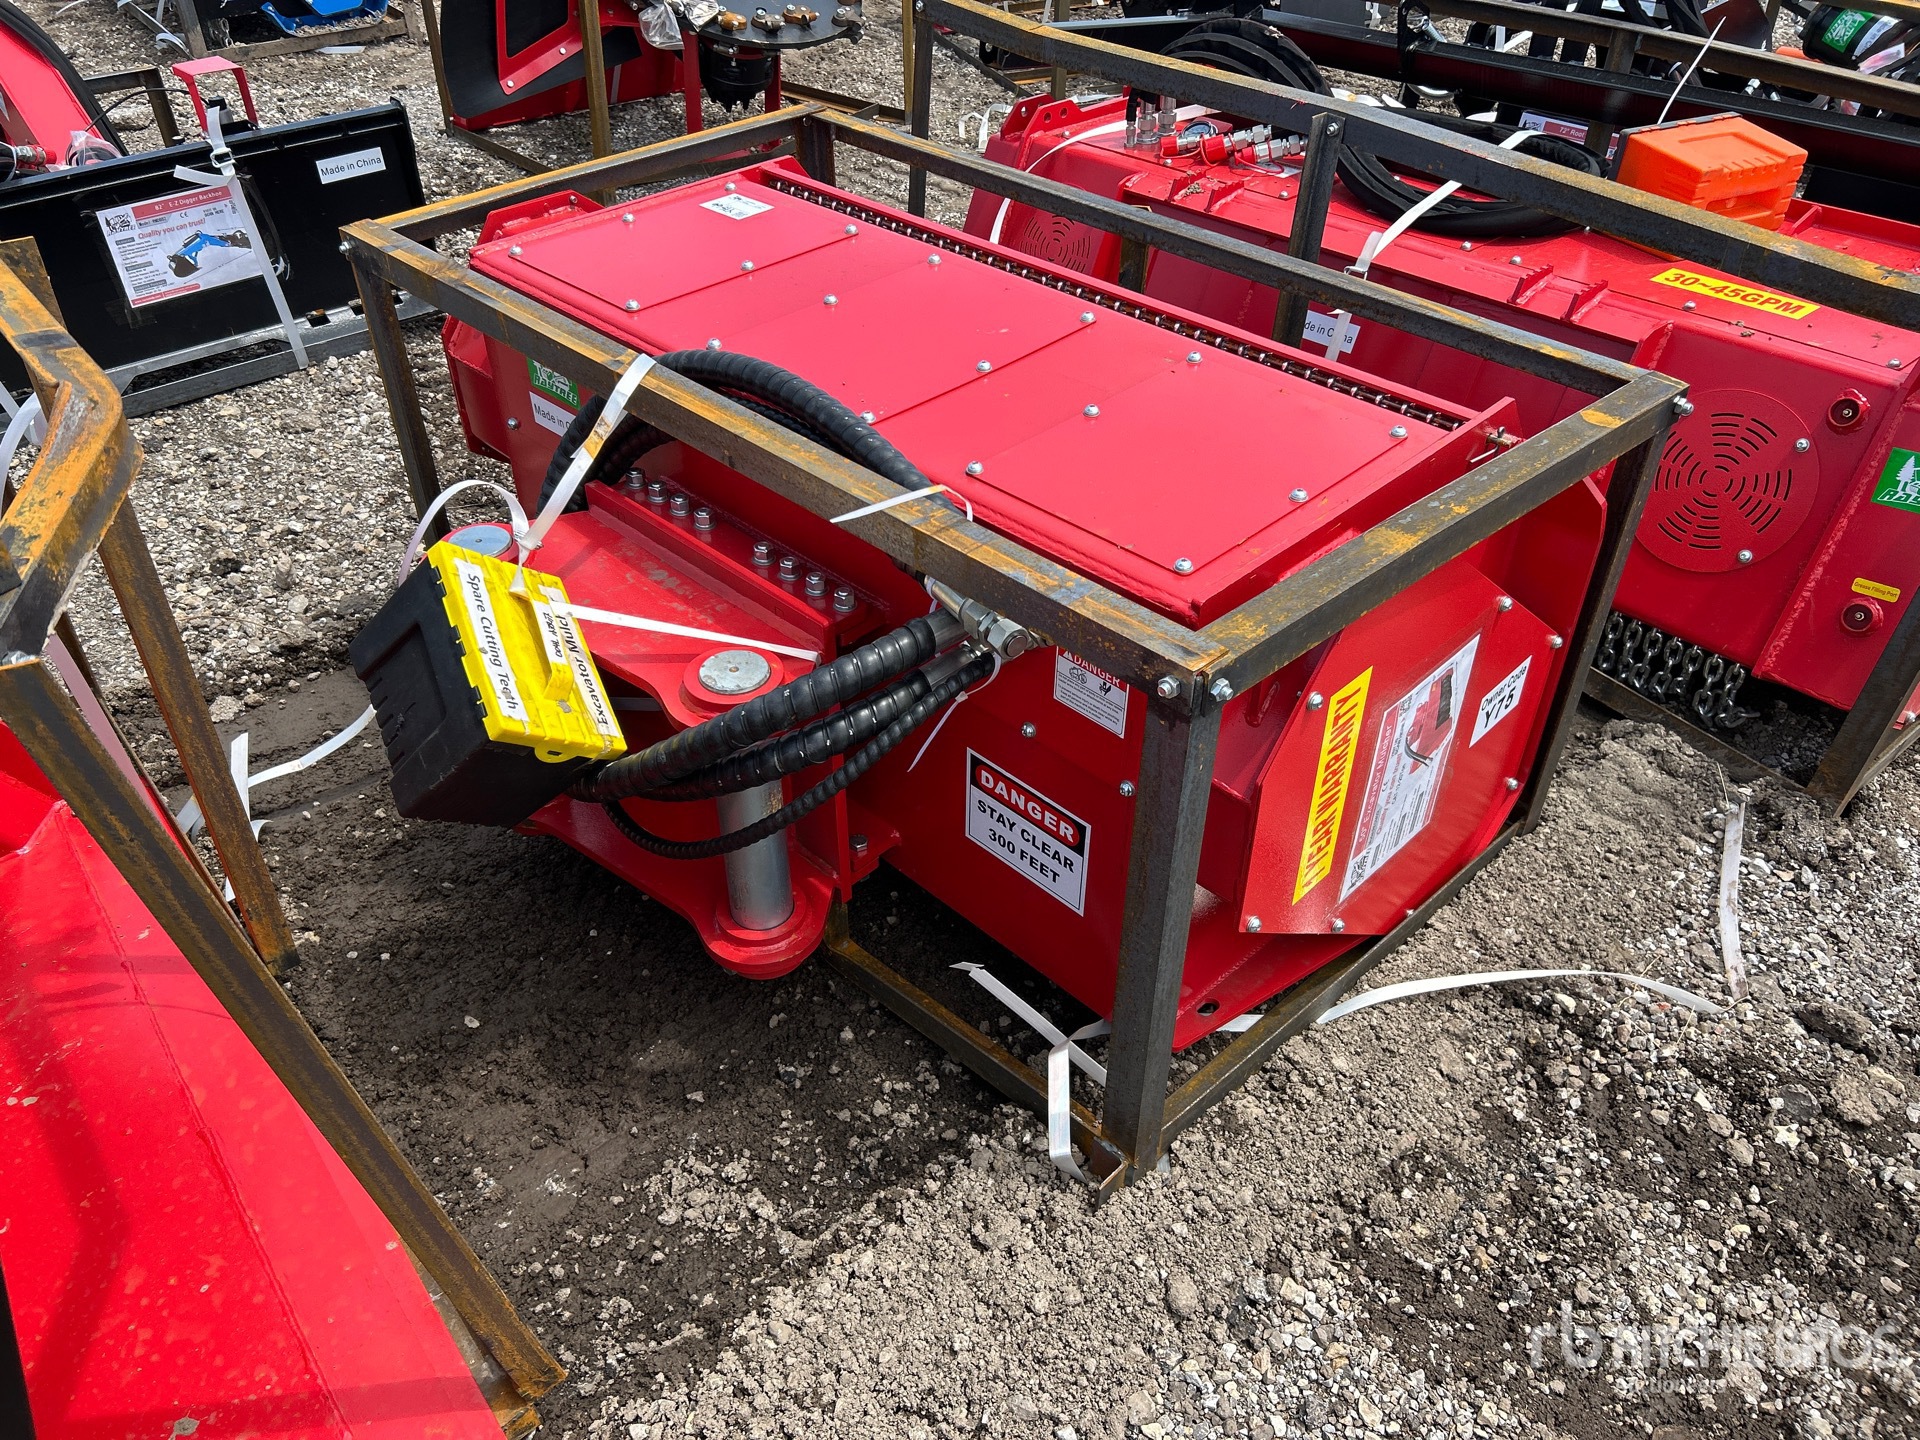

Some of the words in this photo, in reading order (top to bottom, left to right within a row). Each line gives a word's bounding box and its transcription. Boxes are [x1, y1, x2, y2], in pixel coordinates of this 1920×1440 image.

[1570, 129, 1585, 138] Root
[320, 165, 346, 176] Made
[356, 157, 381, 168] China
[179, 196, 198, 206] Digger
[198, 191, 223, 201] Backhoe
[138, 229, 161, 240] Quality
[162, 226, 175, 235] you
[1664, 273, 1805, 314] 30~45GPM
[1317, 323, 1326, 335] in
[534, 403, 556, 424] Made
[557, 415, 565, 429] in
[466, 573, 486, 612] Spare
[480, 616, 503, 668] Cutting
[574, 656, 609, 726] Excavator
[1481, 683, 1507, 712] Owner
[1507, 666, 1527, 688] Code
[1484, 686, 1516, 729] Y75
[1315, 686, 1362, 822] WARRANTY
[1363, 771, 1381, 822] Excavator
[1376, 725, 1392, 772] Mulcher
[981, 769, 1074, 843] DANGER
[977, 799, 1017, 833] STAY
[1020, 828, 1075, 874] CLEAR
[988, 828, 1016, 855] 300
[1020, 848, 1060, 884] FEET
[1304, 807, 1338, 878] YEAR
